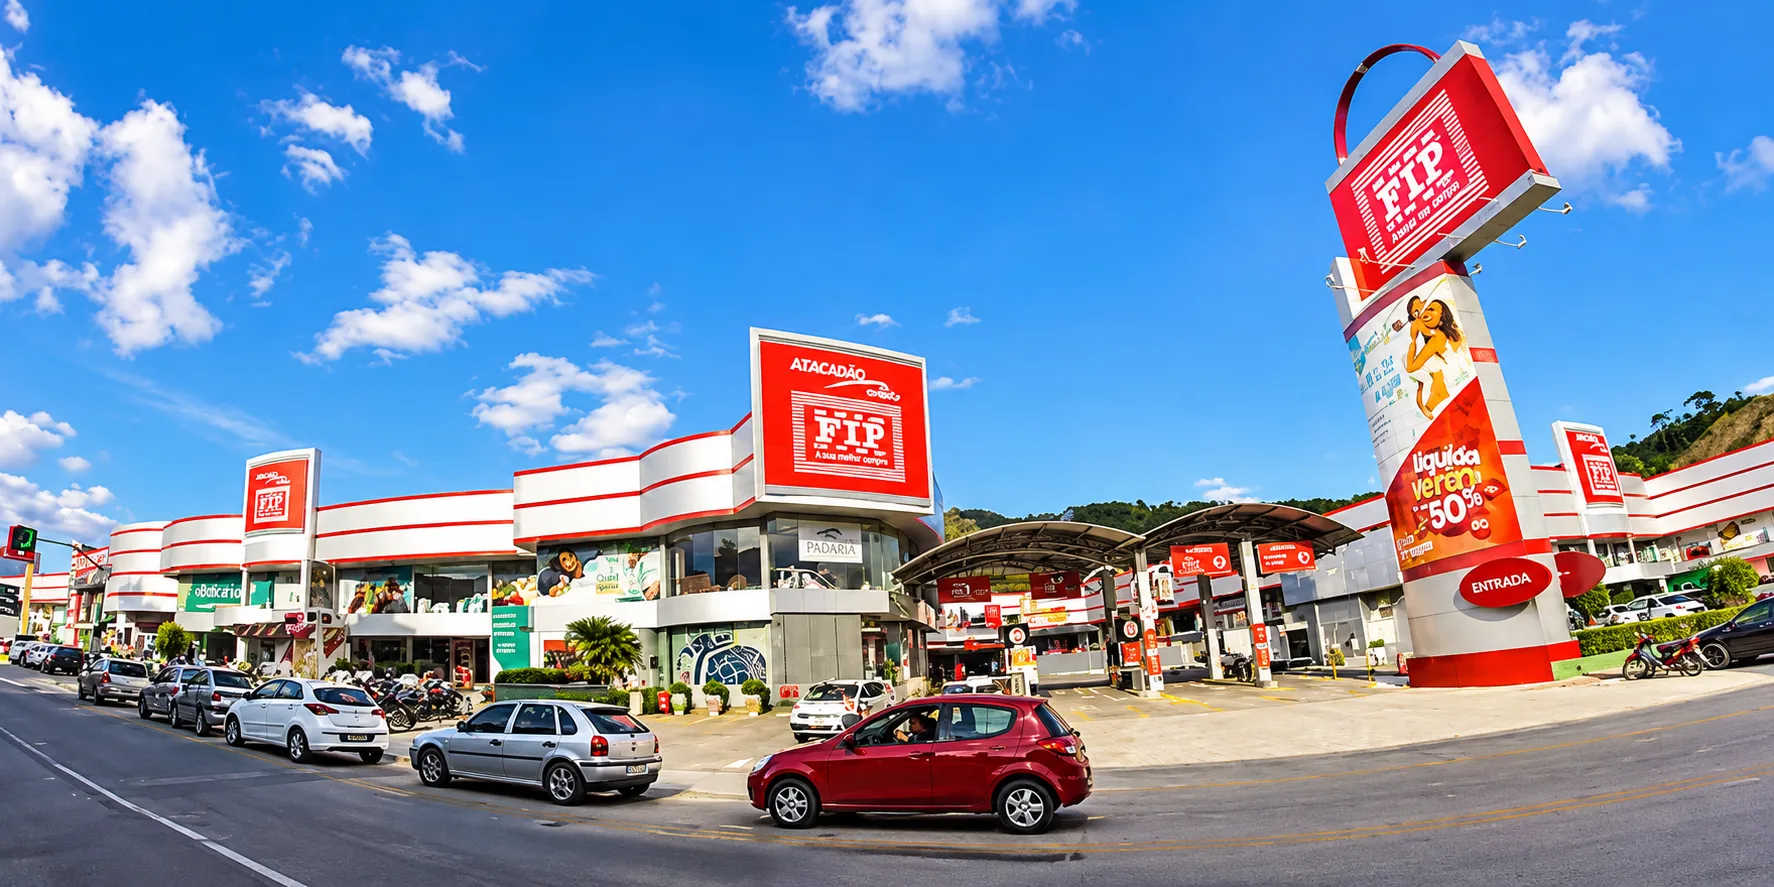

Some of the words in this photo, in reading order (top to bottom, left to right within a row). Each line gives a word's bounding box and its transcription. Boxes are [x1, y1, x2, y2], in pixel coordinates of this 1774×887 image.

[1375, 139, 1443, 222] FIP
[789, 357, 866, 381] ATACADÃO
[814, 415, 885, 449] FIP
[807, 541, 856, 555] PADARIA
[1471, 572, 1532, 594] ENTRADA
